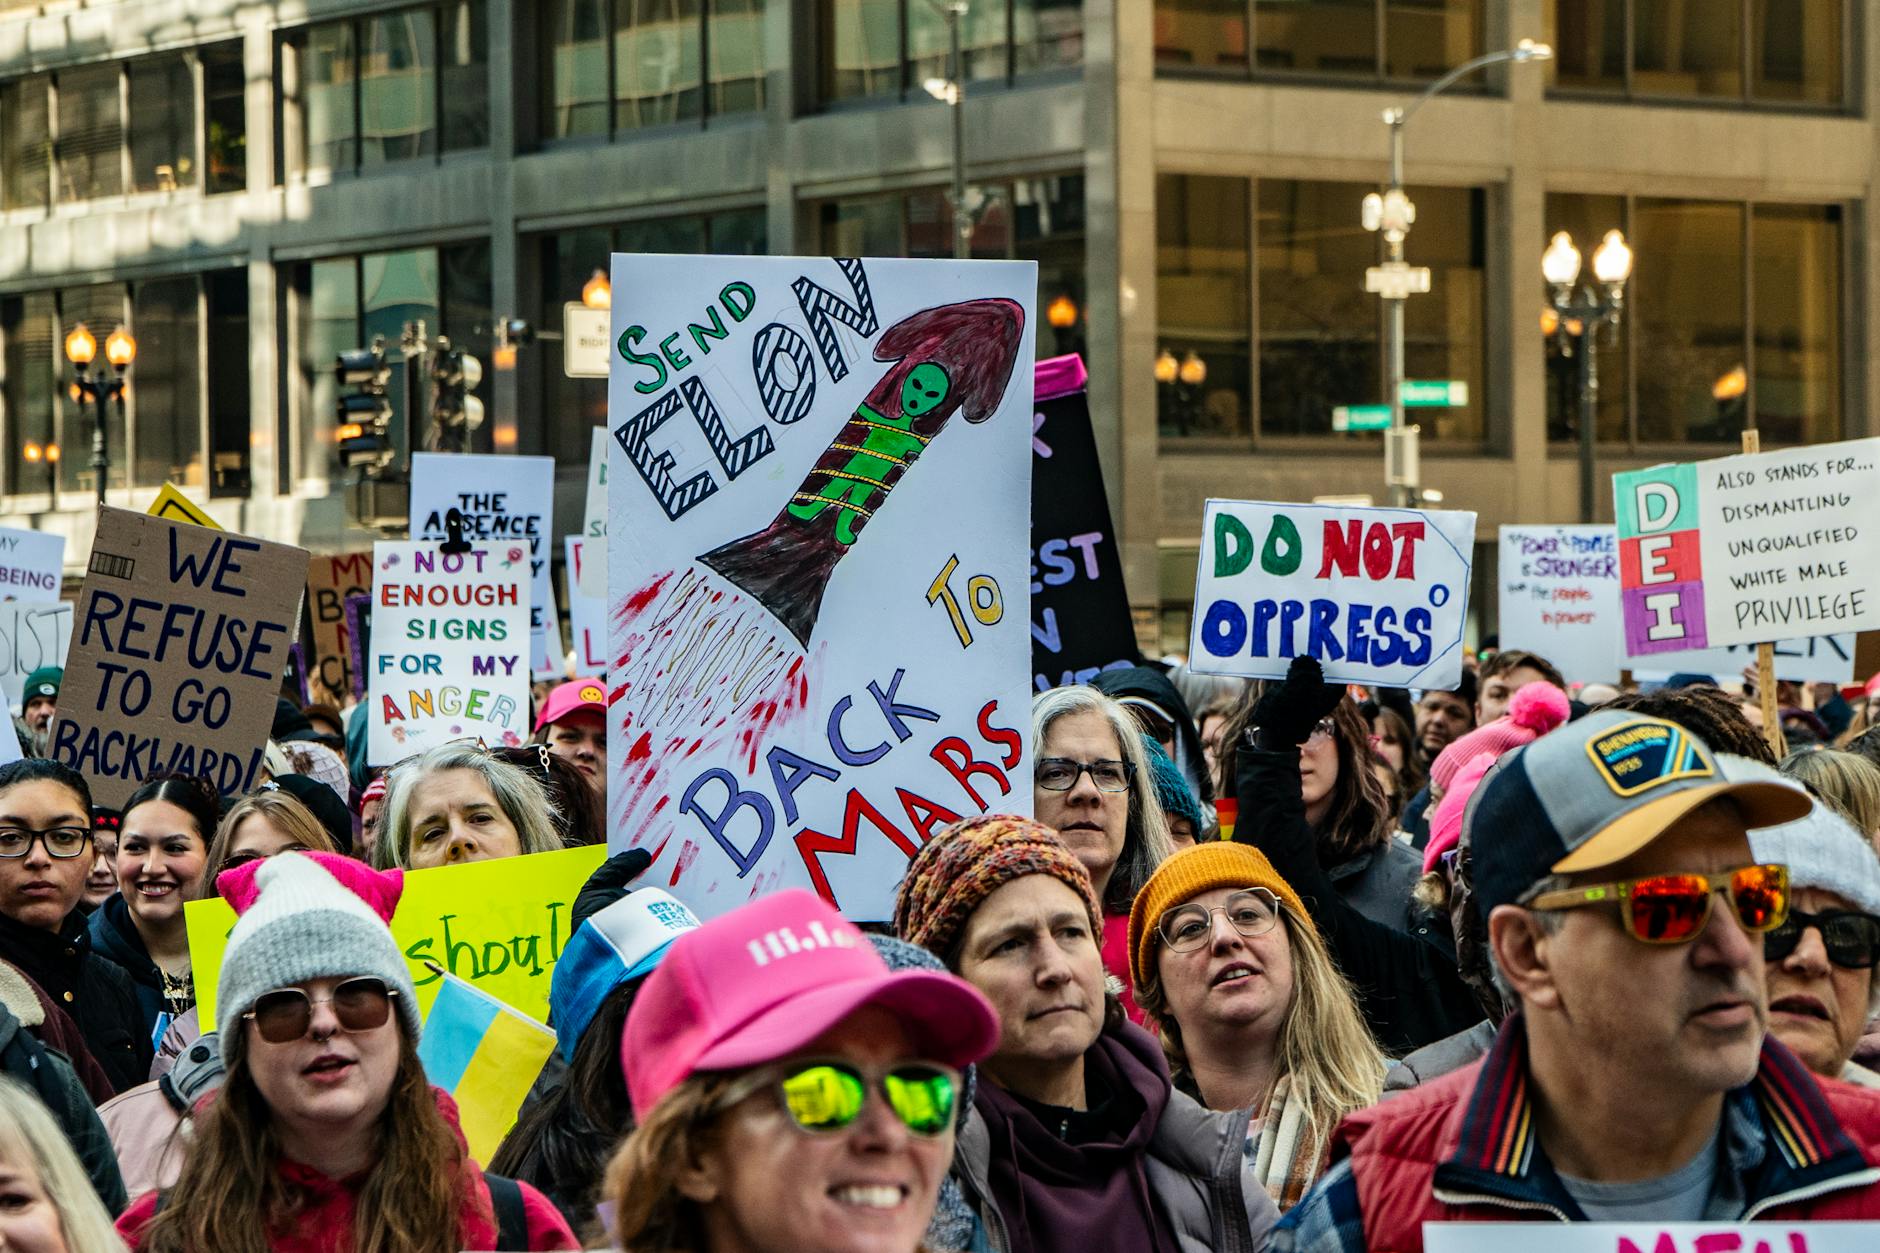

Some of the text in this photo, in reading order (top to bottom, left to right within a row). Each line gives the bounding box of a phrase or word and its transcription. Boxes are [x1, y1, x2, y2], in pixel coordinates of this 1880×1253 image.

[617, 281, 756, 394] SEND
[614, 258, 879, 521] ELON
[458, 493, 507, 512] THE
[1717, 457, 1875, 490] ALSO STANDS FOR...
[1722, 492, 1851, 523] DISMANTLING
[424, 511, 541, 535] ASENCE
[1214, 513, 1425, 581] DO NOT
[1728, 526, 1858, 557] UNQUALIFIED
[169, 527, 260, 597] WE
[381, 584, 518, 606] ENOUGH
[415, 550, 488, 573] NOT
[1635, 482, 1685, 641] DEI
[1730, 560, 1849, 590] WHITE MALE
[81, 590, 287, 680] REFUSE
[406, 619, 508, 641] SIGNS
[926, 553, 1004, 649] TO
[1201, 598, 1432, 668] OPPRESS
[1735, 589, 1867, 630] PRIVILEGE
[96, 662, 231, 730] TO GO
[378, 654, 443, 675] FOR
[472, 655, 519, 676] MY
[382, 685, 517, 730] ANGER
[52, 719, 264, 797] BACKWARD!
[679, 668, 940, 878] BACK
[793, 699, 1022, 911] MARS
[405, 902, 572, 986] shoul
